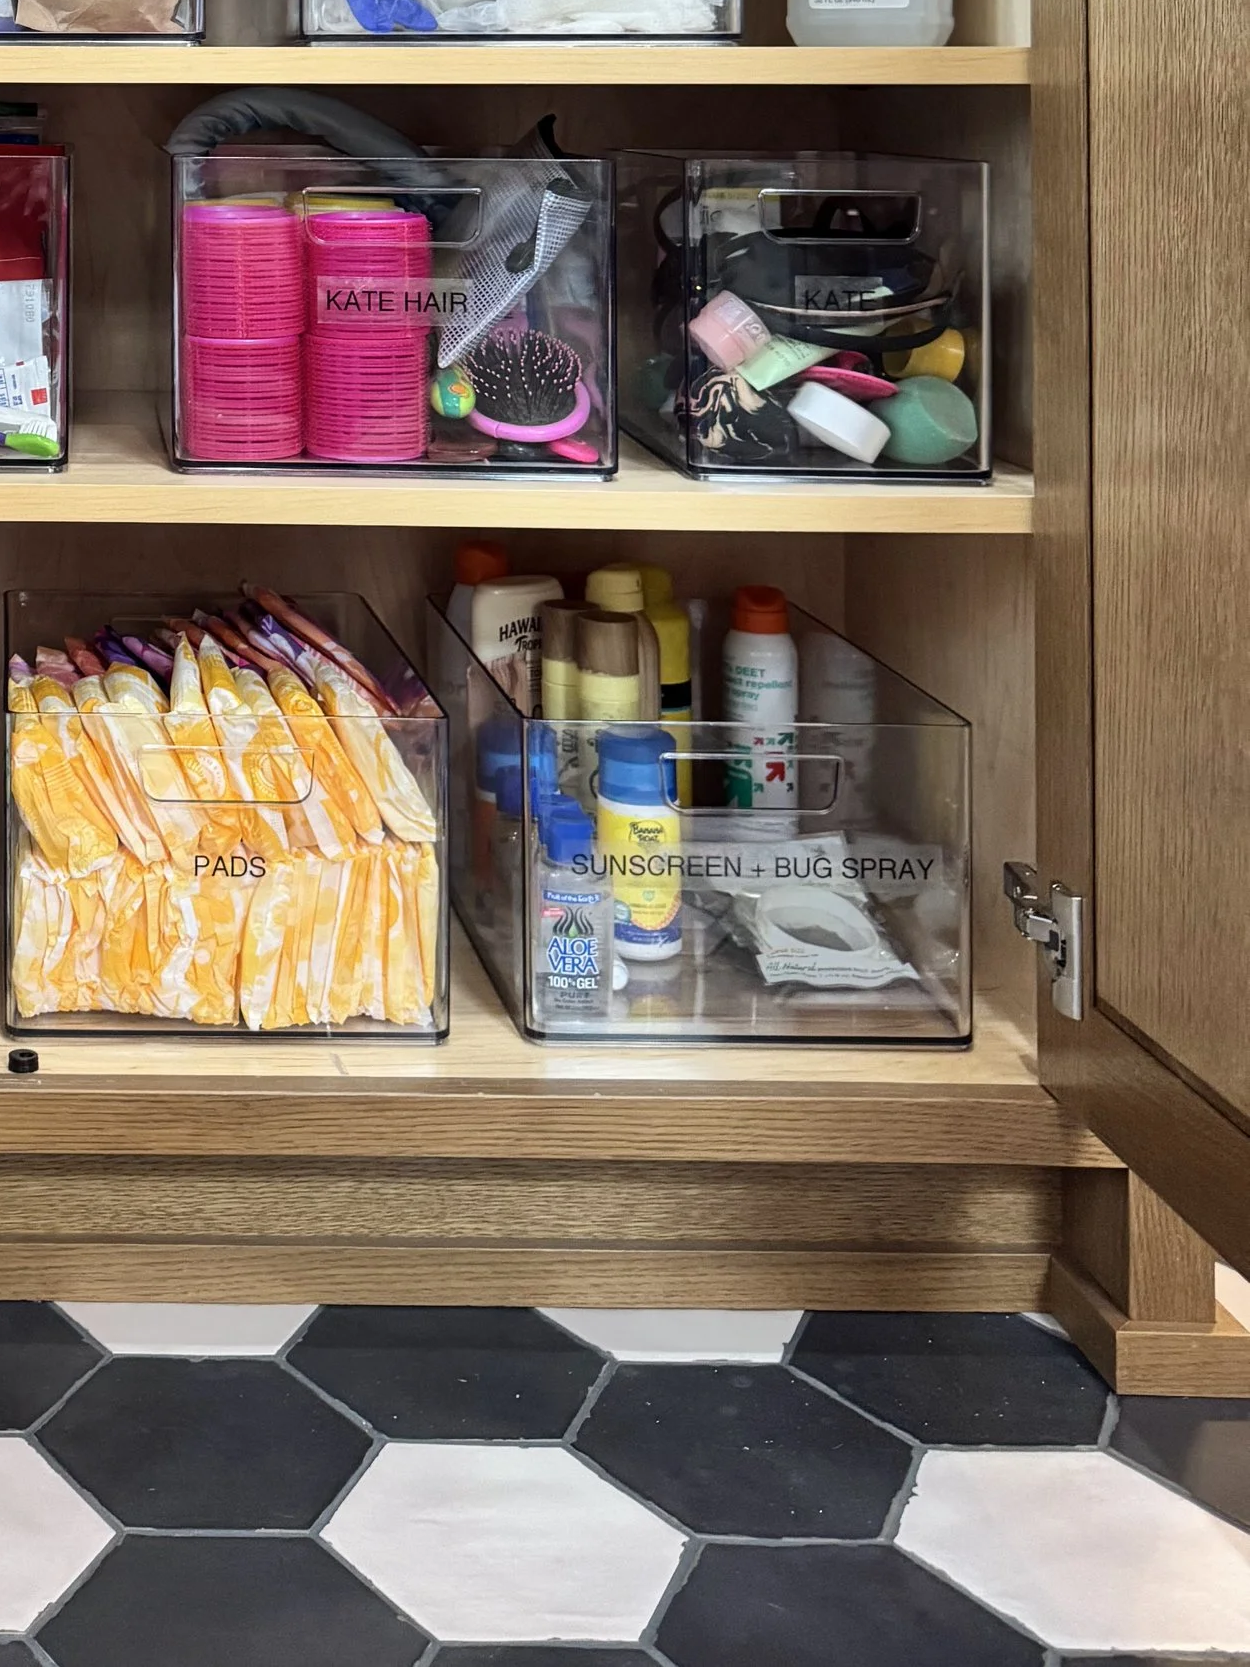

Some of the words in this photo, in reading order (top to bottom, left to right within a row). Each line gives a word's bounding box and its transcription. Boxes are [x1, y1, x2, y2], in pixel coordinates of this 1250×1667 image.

[326, 290, 396, 312] KATE
[404, 291, 469, 314] HAIR
[804, 289, 877, 312] KATE
[736, 666, 766, 678] DEET
[746, 678, 793, 690] repellent
[195, 855, 266, 878] PADS
[571, 853, 741, 878] SUNSCREEN
[751, 860, 766, 877] +
[775, 857, 832, 879] BUG
[841, 858, 935, 880] SPRAY
[548, 936, 598, 955] ALOE
[548, 954, 599, 975] VERA
[766, 962, 780, 972] All
[781, 962, 817, 972] Natural
[576, 976, 598, 989] GEL
